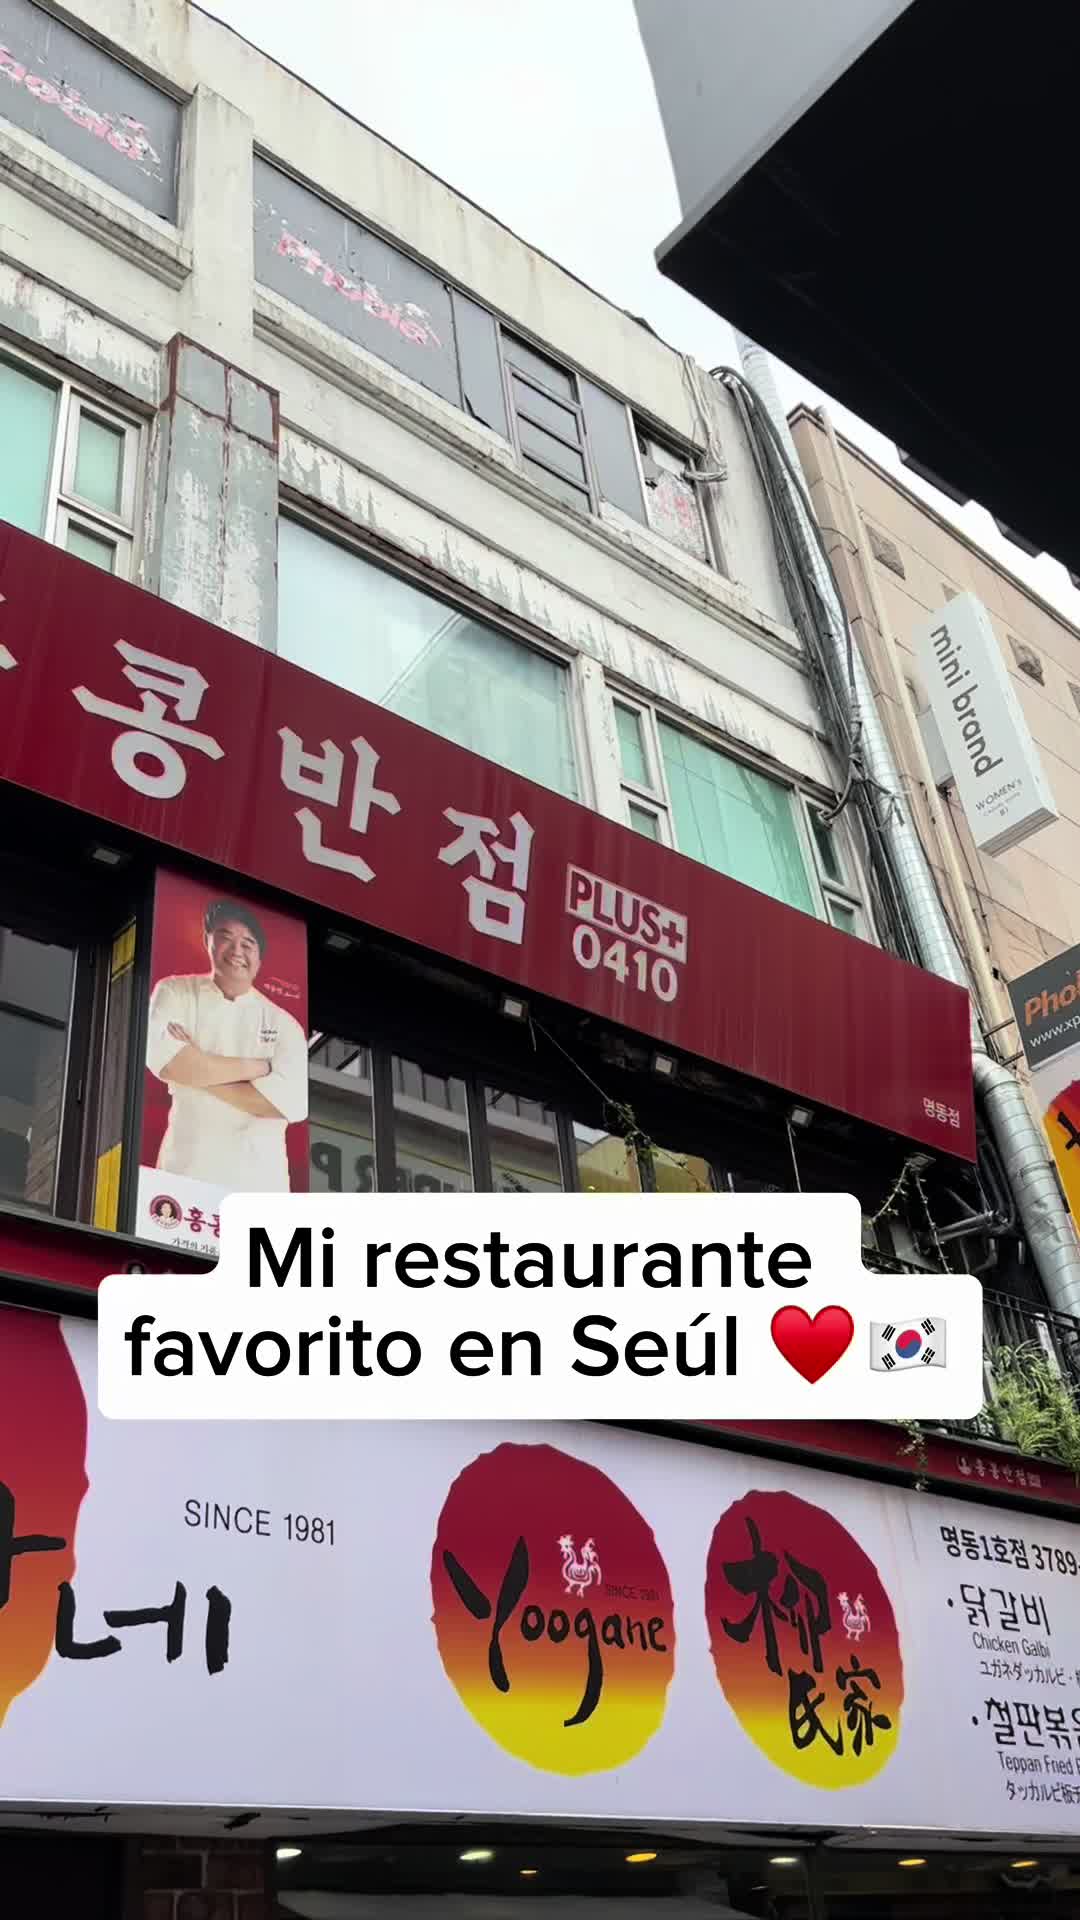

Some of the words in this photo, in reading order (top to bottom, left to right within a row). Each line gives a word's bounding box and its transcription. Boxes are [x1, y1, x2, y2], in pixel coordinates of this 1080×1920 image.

[931, 624, 971, 689] mini
[952, 684, 1004, 778] brand
[0, 592, 536, 944] 콩반점
[569, 869, 684, 949] PLUS+
[572, 923, 679, 1003] 0410
[923, 1097, 961, 1129] 명동점
[184, 1499, 271, 1537] SINCE
[283, 1513, 334, 1546] 1981
[940, 1526, 1030, 1570] 명동1호점
[1031, 1543, 1080, 1576] 3789
[442, 1535, 667, 1727] Yoogane
[960, 1583, 1051, 1636] 닭갈비
[972, 1630, 1020, 1655] Chicken
[1021, 1637, 1051, 1659] Galbi
[996, 1750, 1042, 1775] Teppan
[1043, 1754, 1074, 1776] Fried
